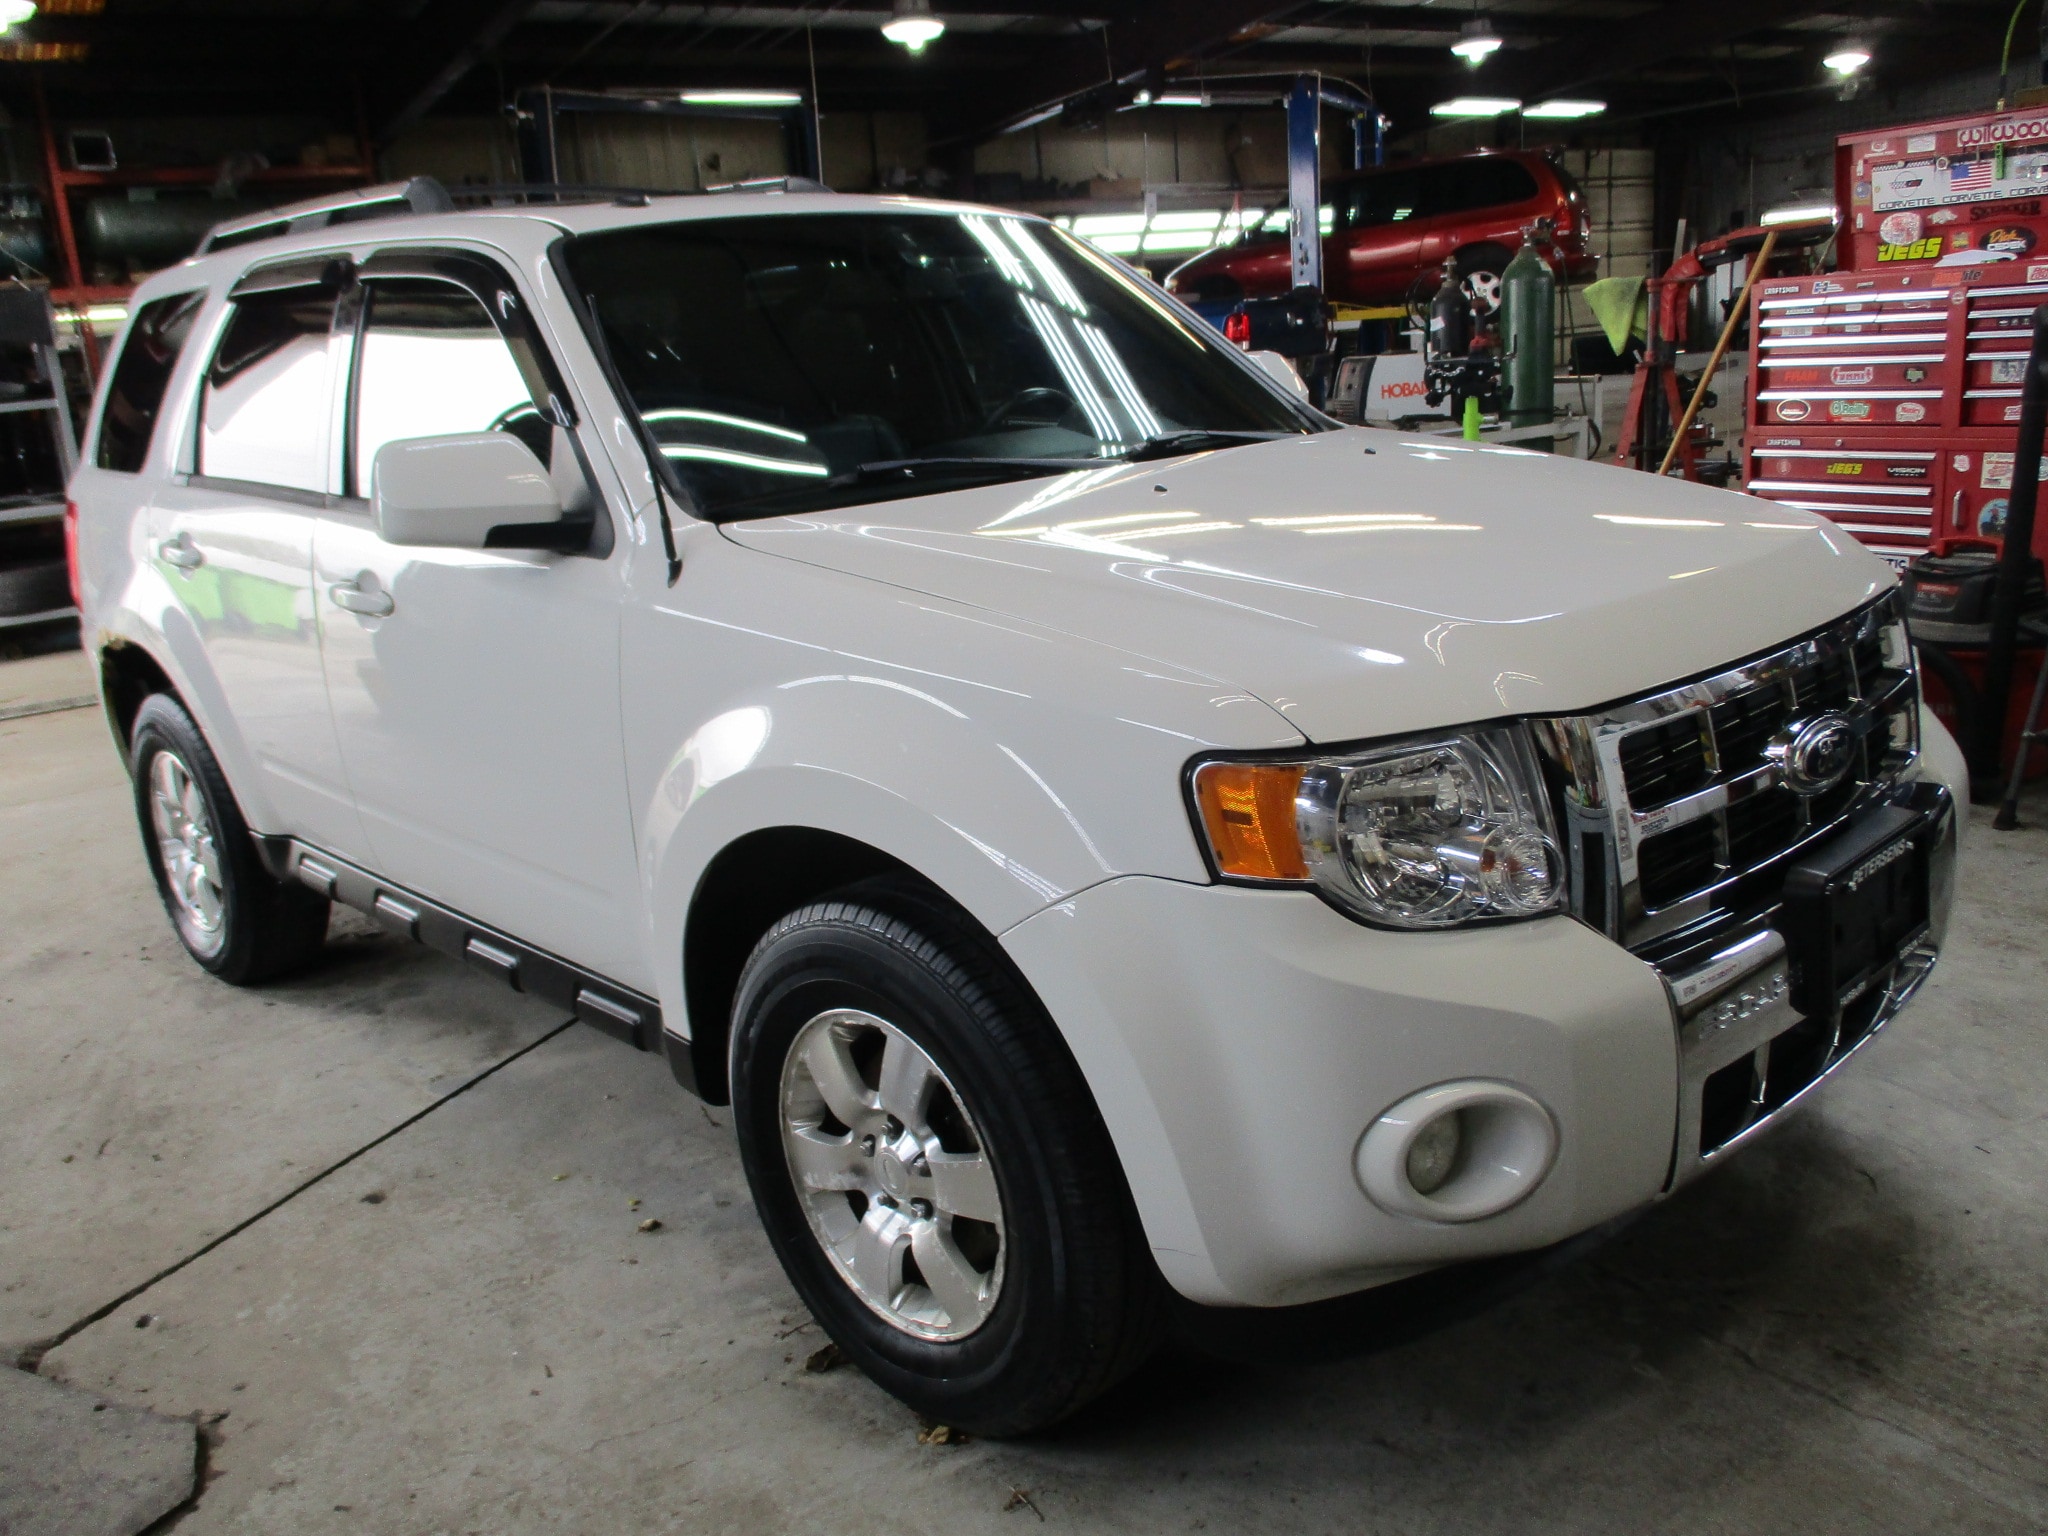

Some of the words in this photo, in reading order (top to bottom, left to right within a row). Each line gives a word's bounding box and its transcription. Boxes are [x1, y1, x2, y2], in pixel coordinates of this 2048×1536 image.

[1879, 196, 1935, 210] CORVETTE
[1942, 190, 2002, 204] CORVETTE
[1877, 237, 1943, 262] JEGS
[1381, 381, 1430, 399] HOBAR
